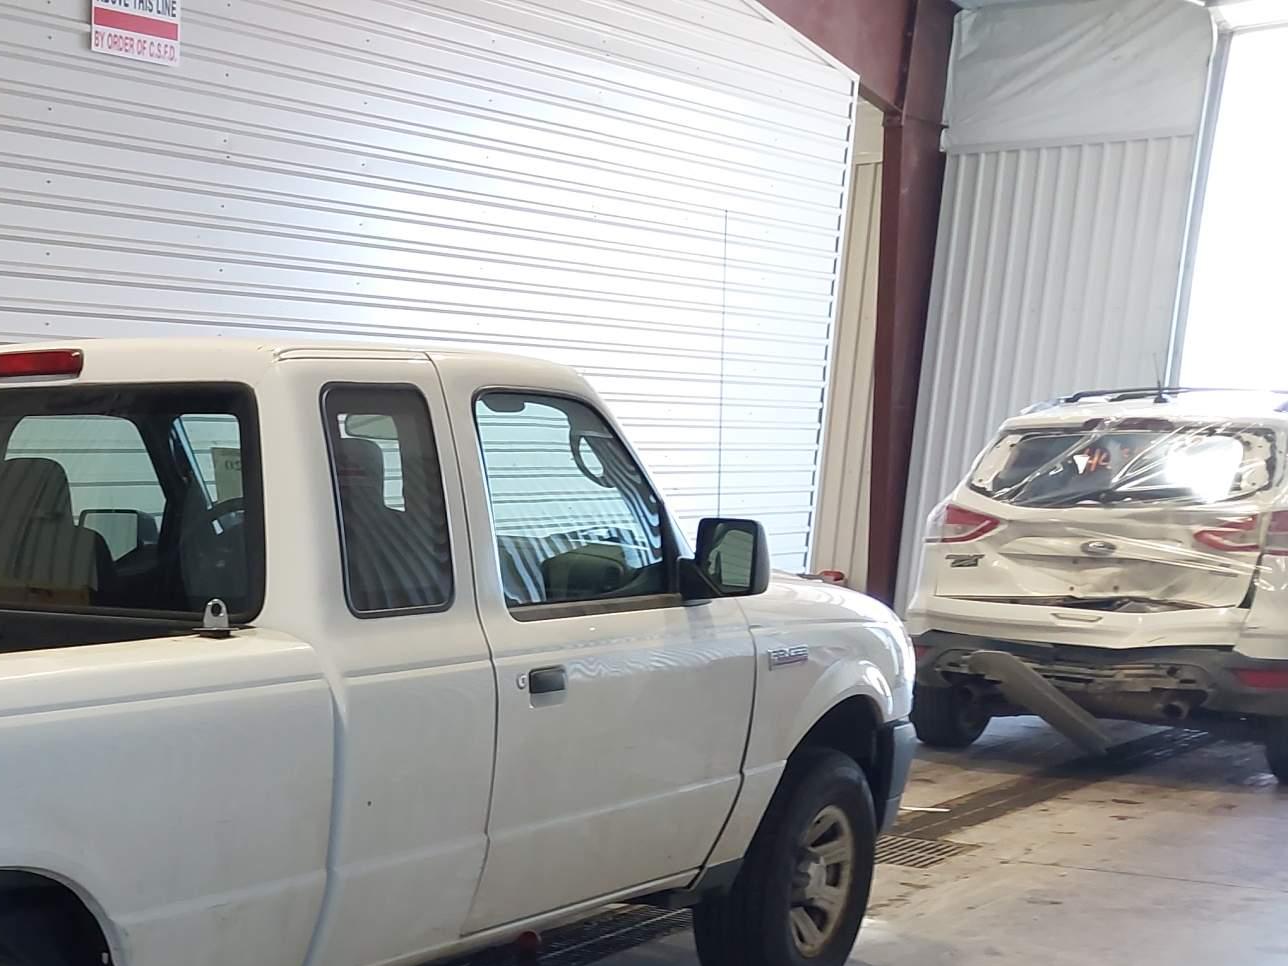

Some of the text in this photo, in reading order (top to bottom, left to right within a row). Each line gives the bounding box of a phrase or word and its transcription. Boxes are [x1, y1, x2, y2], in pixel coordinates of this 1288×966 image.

[156, 0, 176, 17] LINE
[95, 31, 105, 47] BY
[107, 33, 134, 53] ORDER
[137, 40, 147, 55] OF
